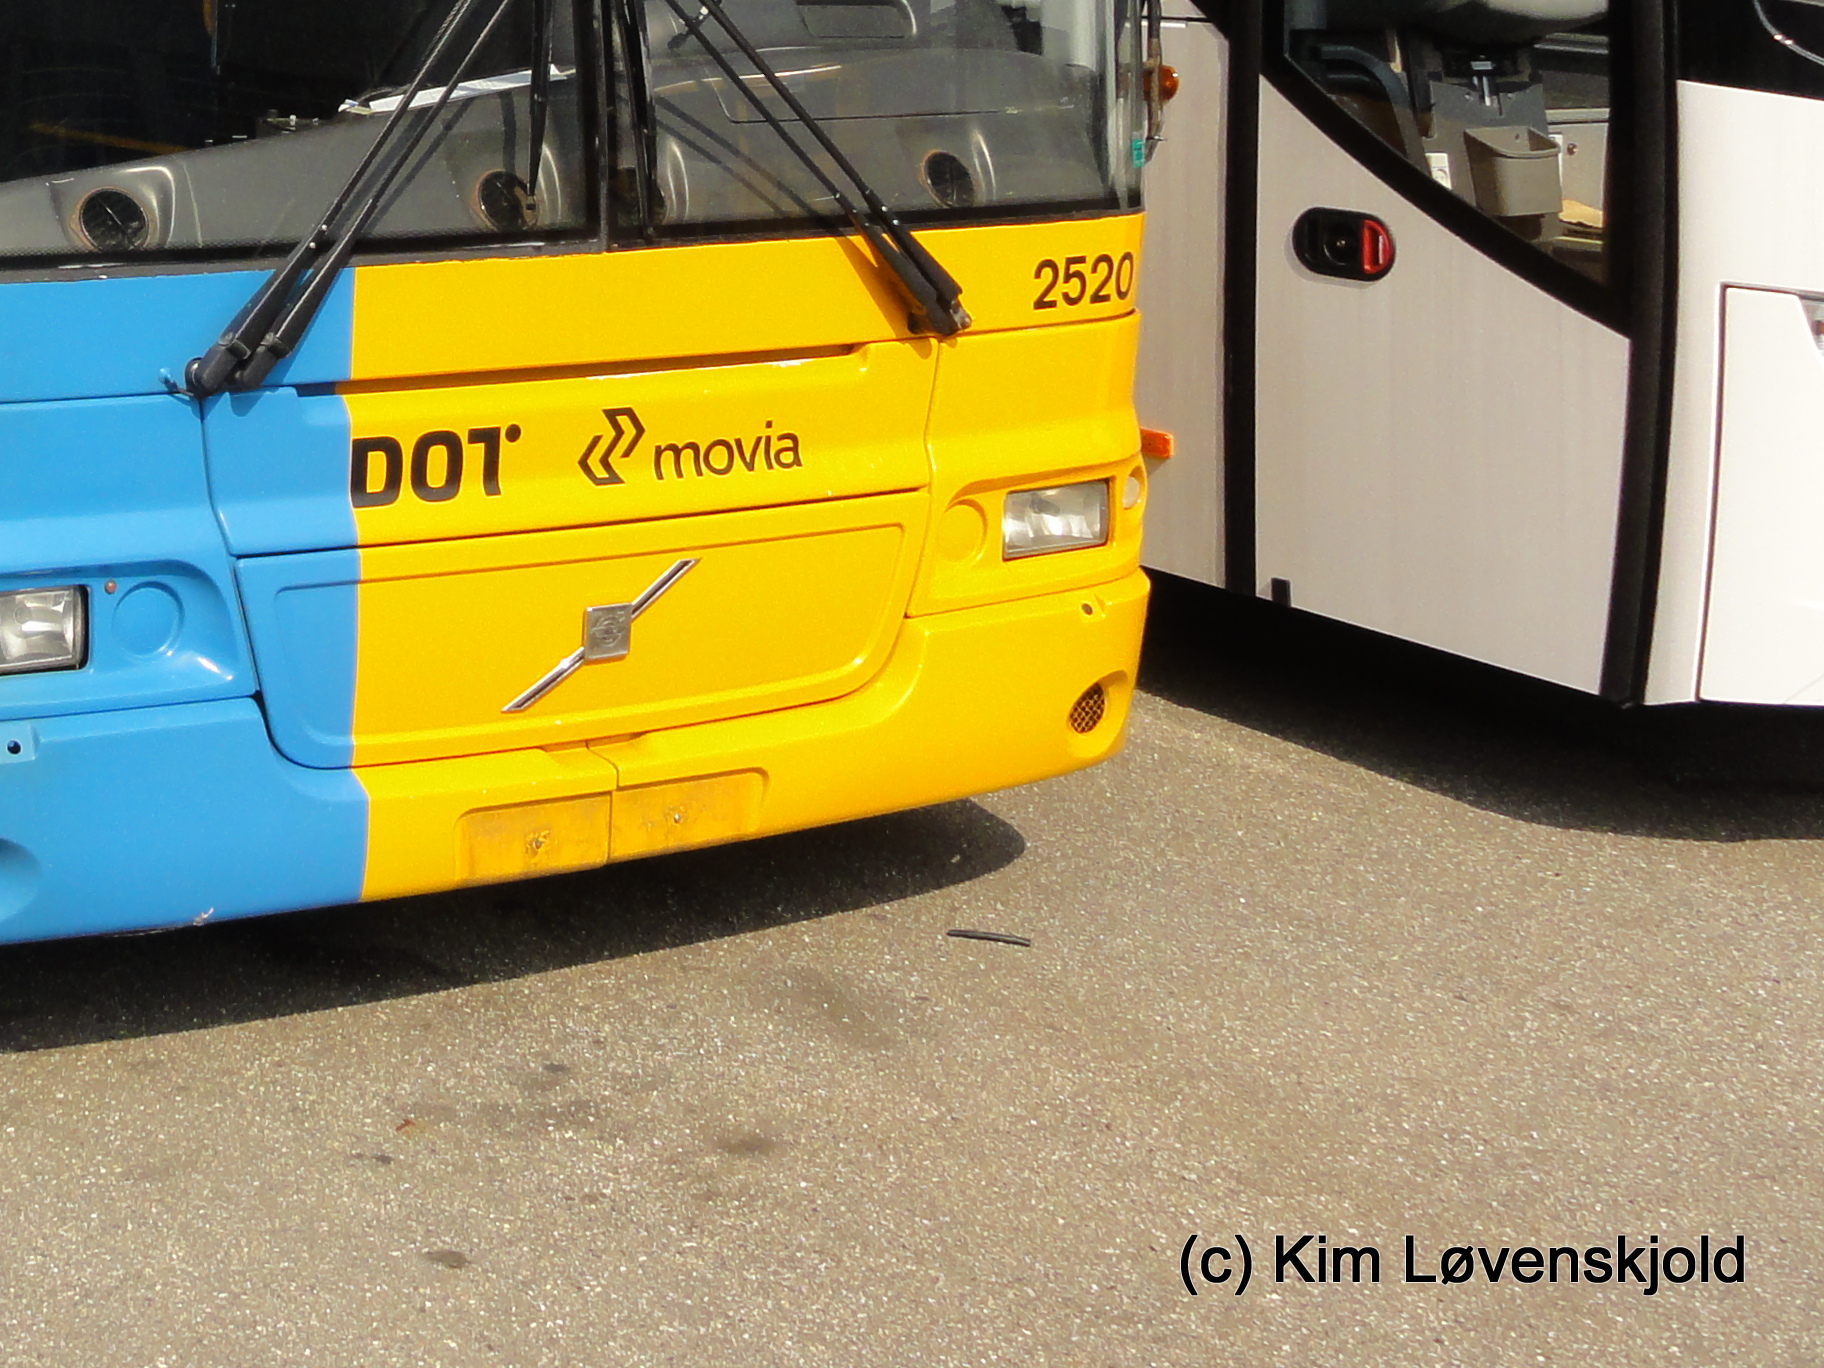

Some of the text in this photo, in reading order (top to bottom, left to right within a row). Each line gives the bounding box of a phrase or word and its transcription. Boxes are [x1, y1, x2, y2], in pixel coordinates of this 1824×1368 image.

[1033, 251, 1136, 310] 2520
[351, 425, 521, 508] DOT
[653, 419, 803, 482] movia
